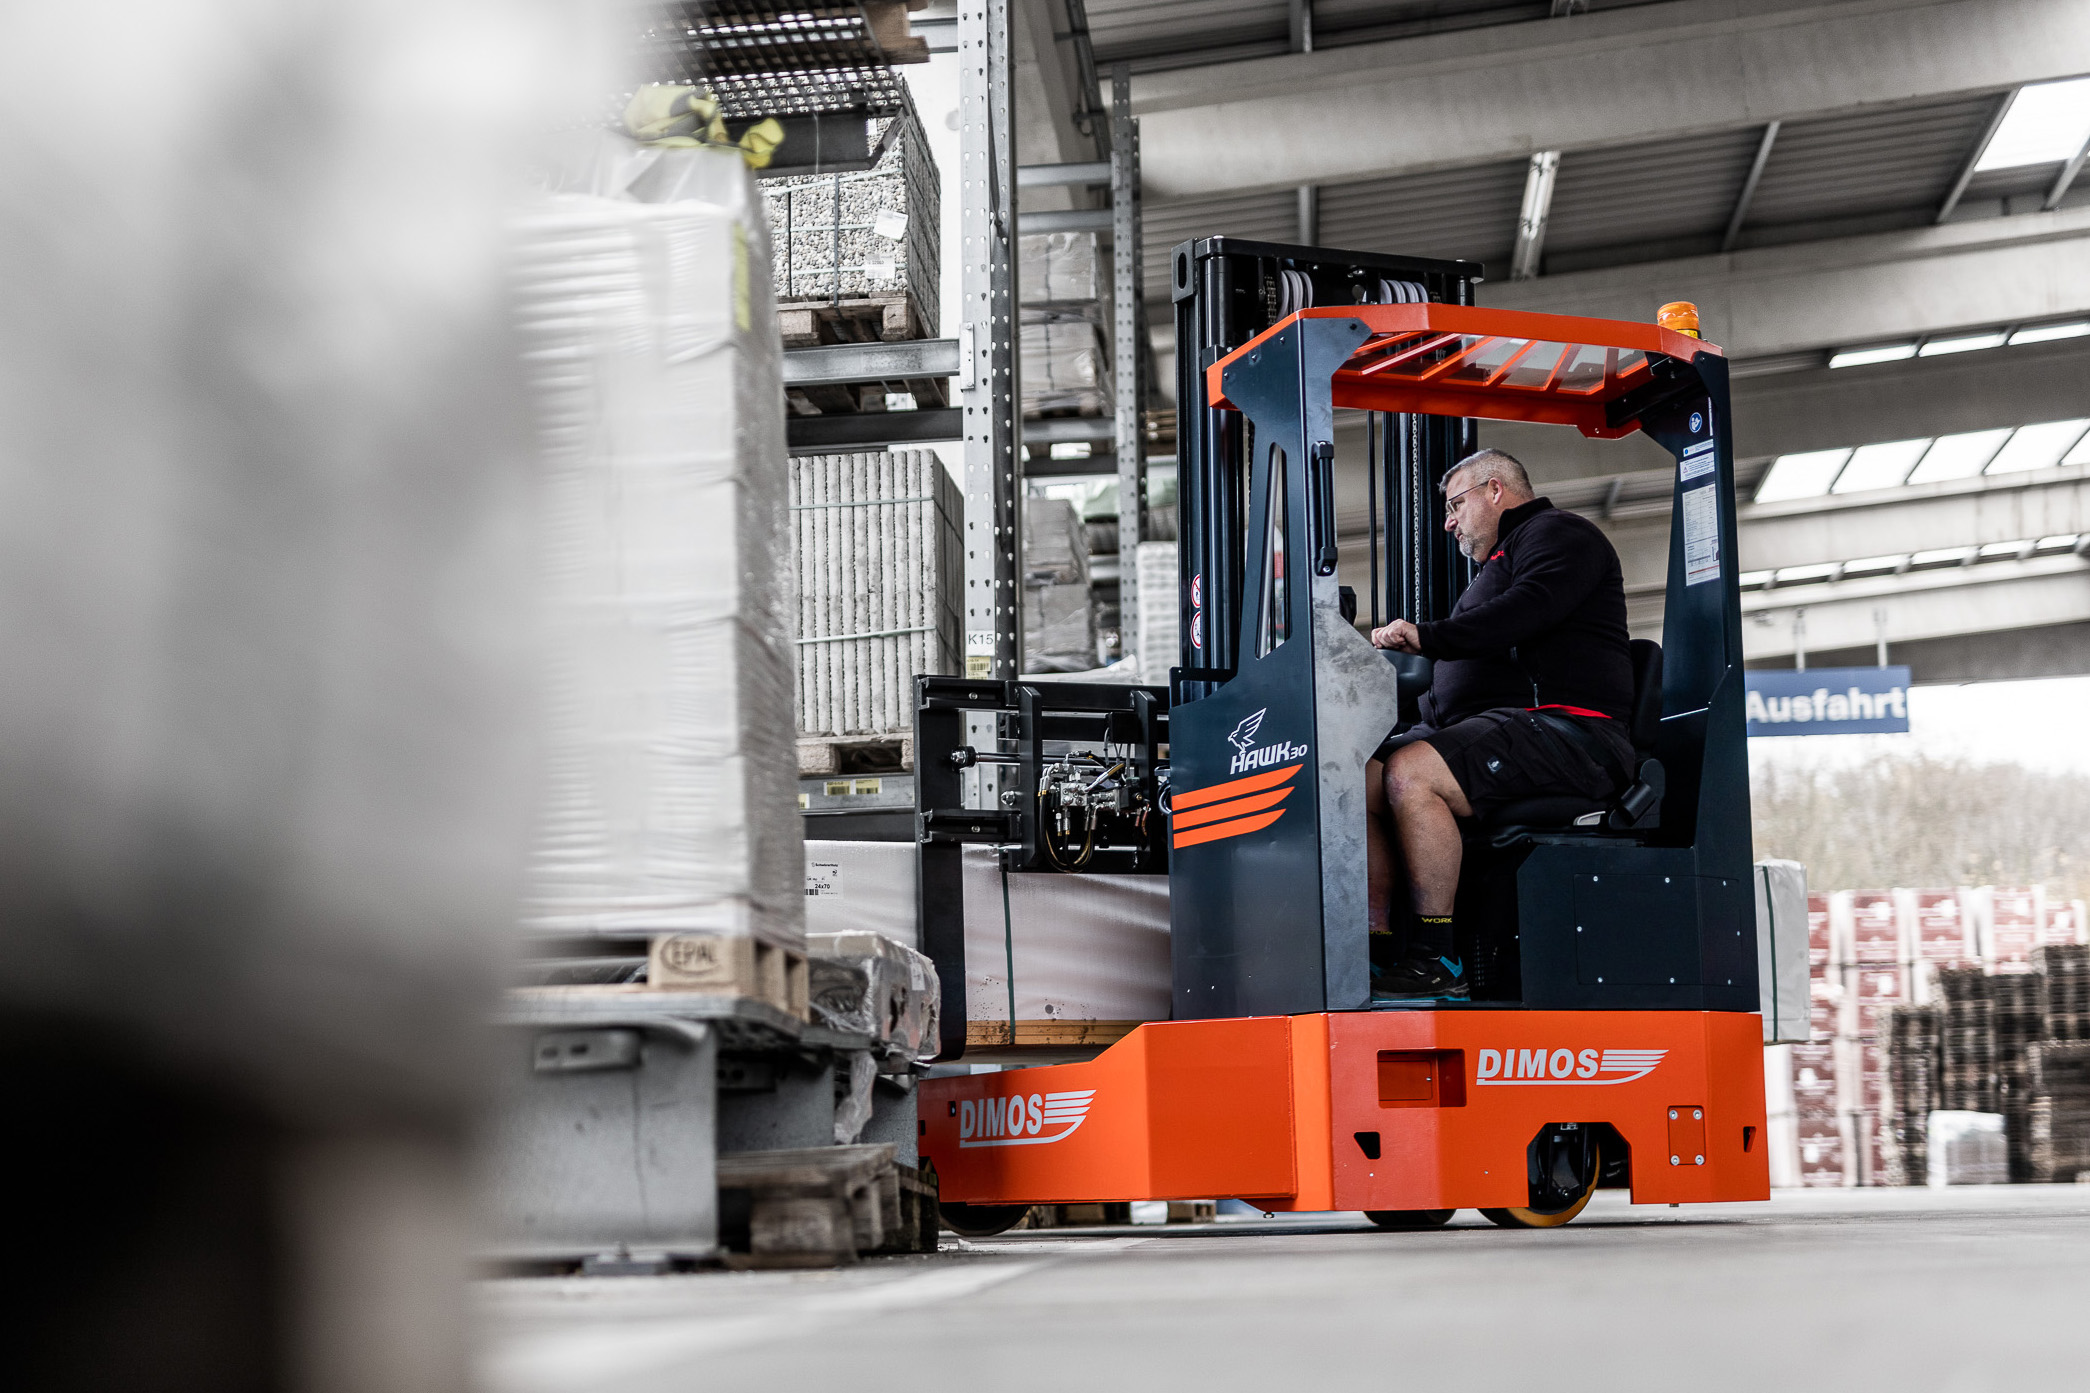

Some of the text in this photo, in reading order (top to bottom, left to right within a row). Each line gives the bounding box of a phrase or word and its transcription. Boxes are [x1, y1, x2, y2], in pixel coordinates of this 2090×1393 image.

[968, 633, 994, 645] K15
[1747, 686, 1906, 723] Ausfahrt
[1476, 1048, 1599, 1079] DIMOS
[960, 1093, 1043, 1139] DIMOS
